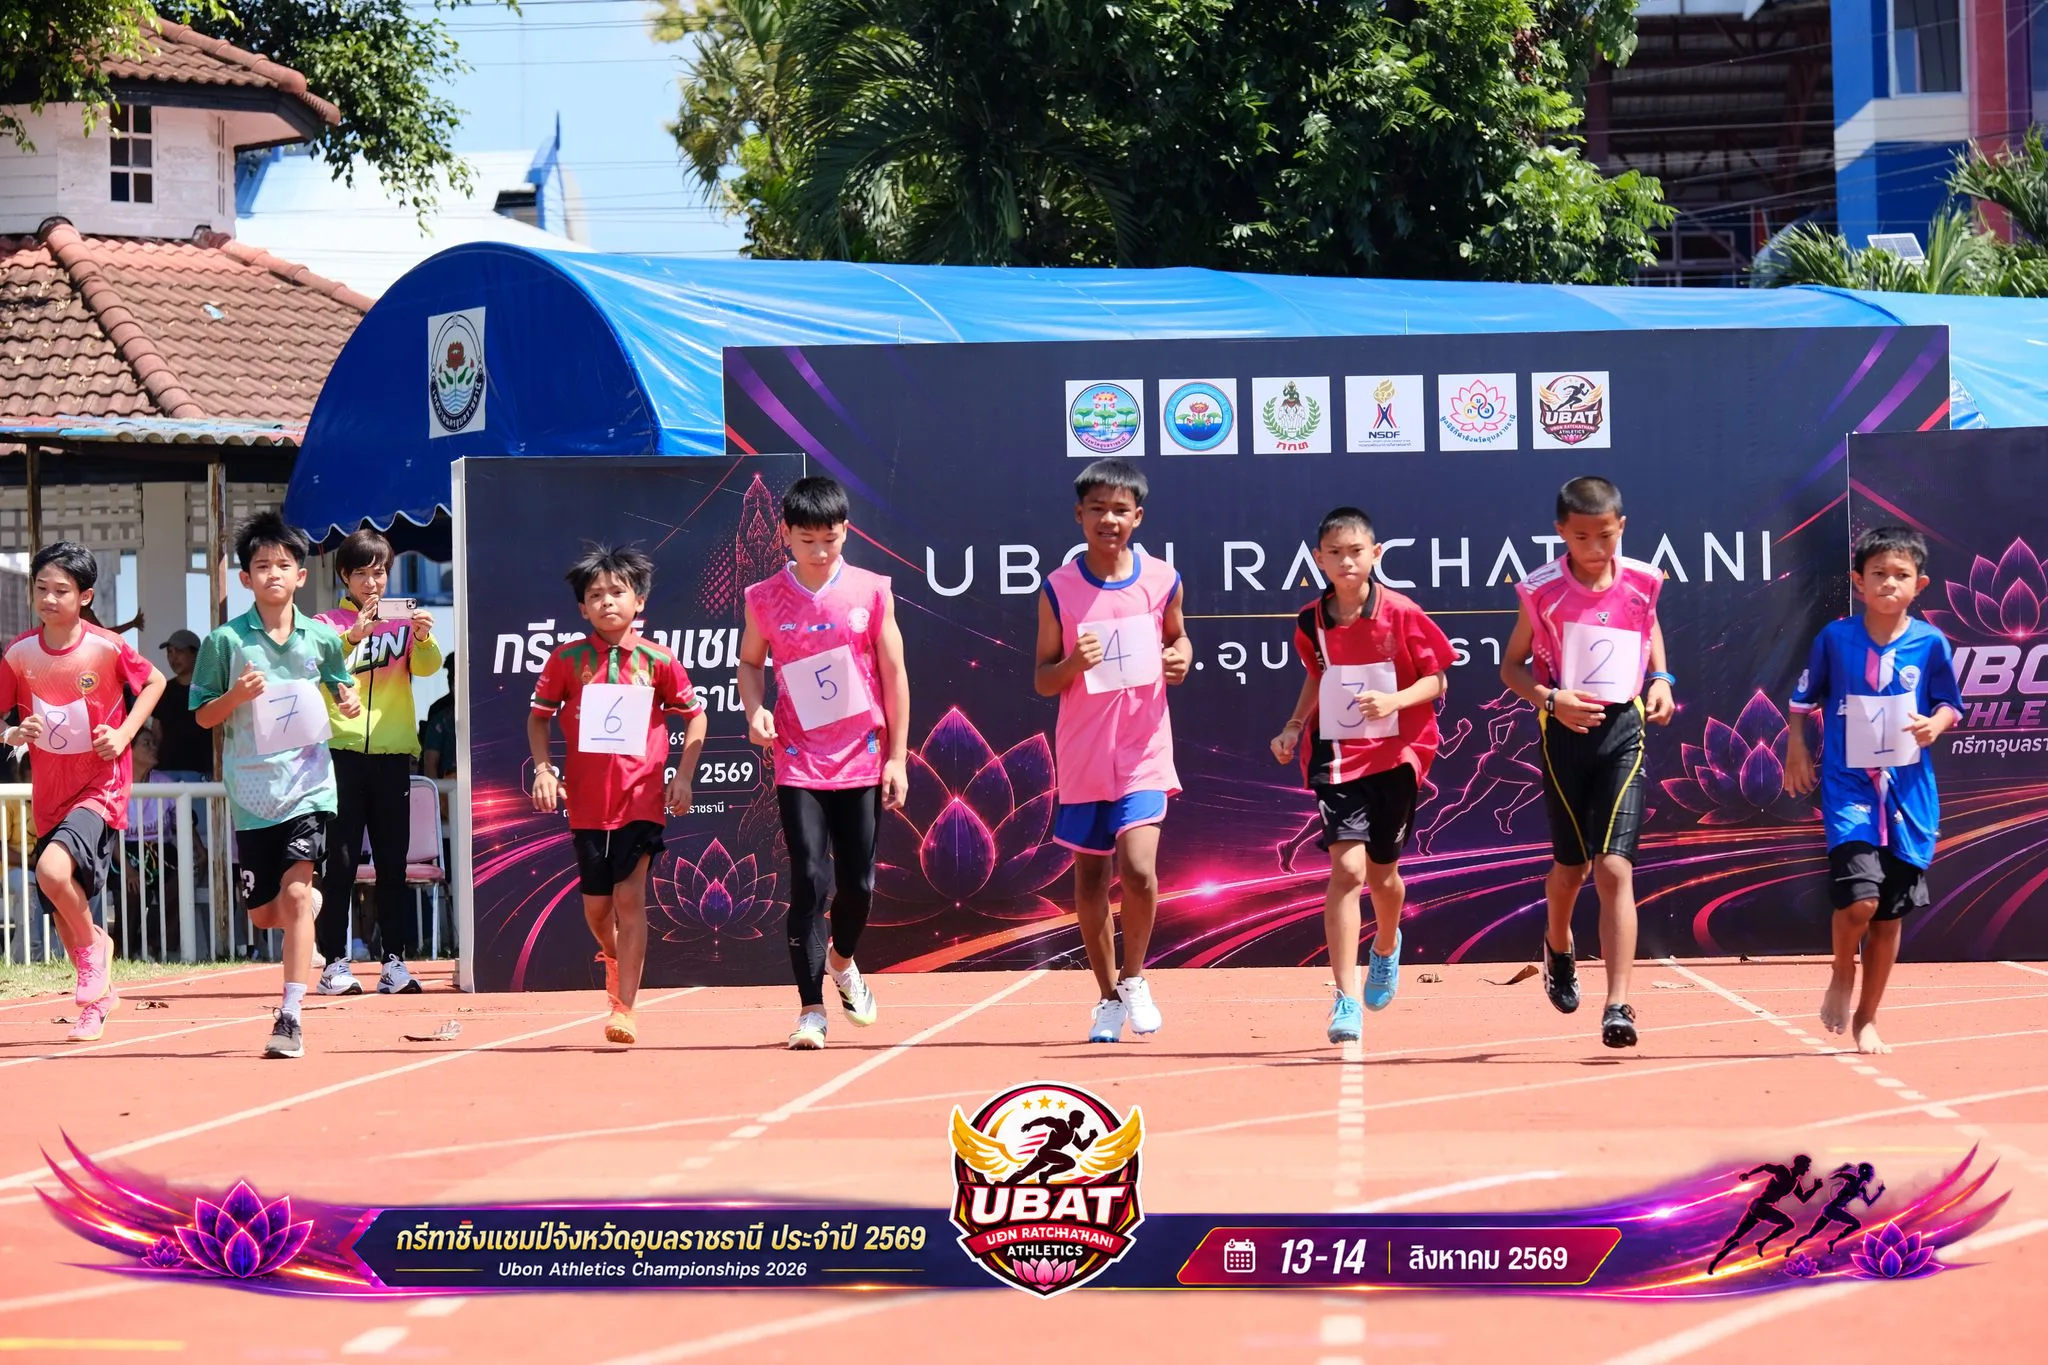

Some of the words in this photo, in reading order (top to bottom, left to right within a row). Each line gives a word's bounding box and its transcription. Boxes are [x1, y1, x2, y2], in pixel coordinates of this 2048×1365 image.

[1368, 431, 1400, 439] NSDF
[1545, 410, 1598, 425] UBAT
[1276, 441, 1309, 451] กกท
[926, 541, 1174, 597] UB
[1223, 530, 1771, 591] RACHATANI
[1102, 628, 1132, 673] 4
[1582, 638, 1616, 685] 2
[814, 664, 838, 701] 5
[269, 694, 299, 733] 7
[603, 696, 623, 734] 6
[1336, 682, 1366, 728] 3
[45, 710, 68, 750] 8
[1871, 706, 1895, 755] 1
[699, 762, 754, 784] 2569
